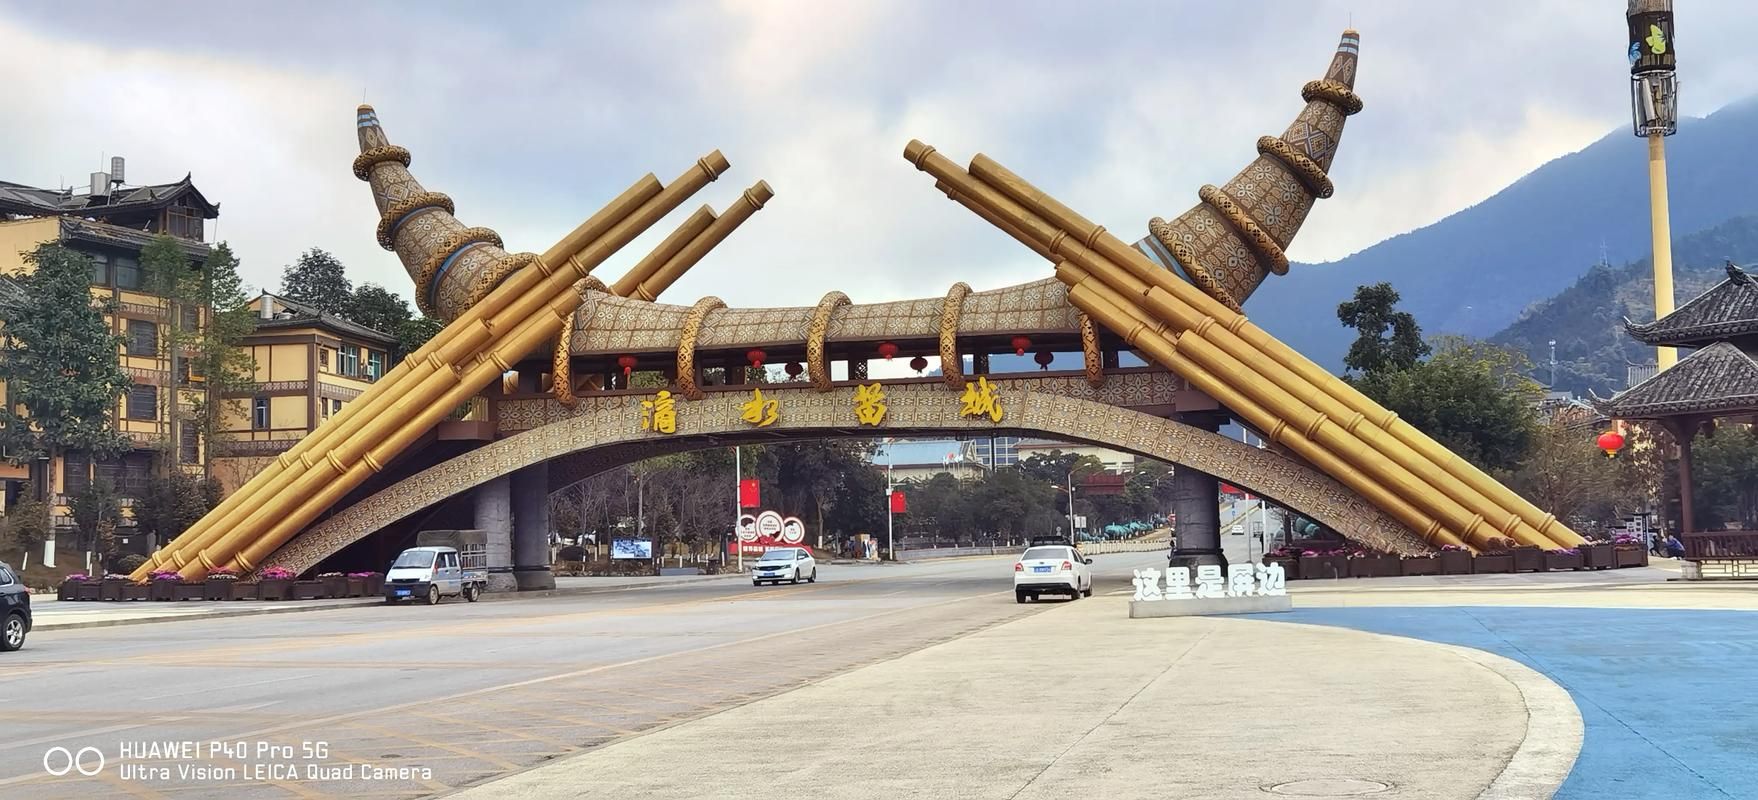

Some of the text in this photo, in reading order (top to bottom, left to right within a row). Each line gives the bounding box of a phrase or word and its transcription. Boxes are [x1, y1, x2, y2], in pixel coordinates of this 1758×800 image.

[1132, 562, 1286, 601] 这里是屏边
